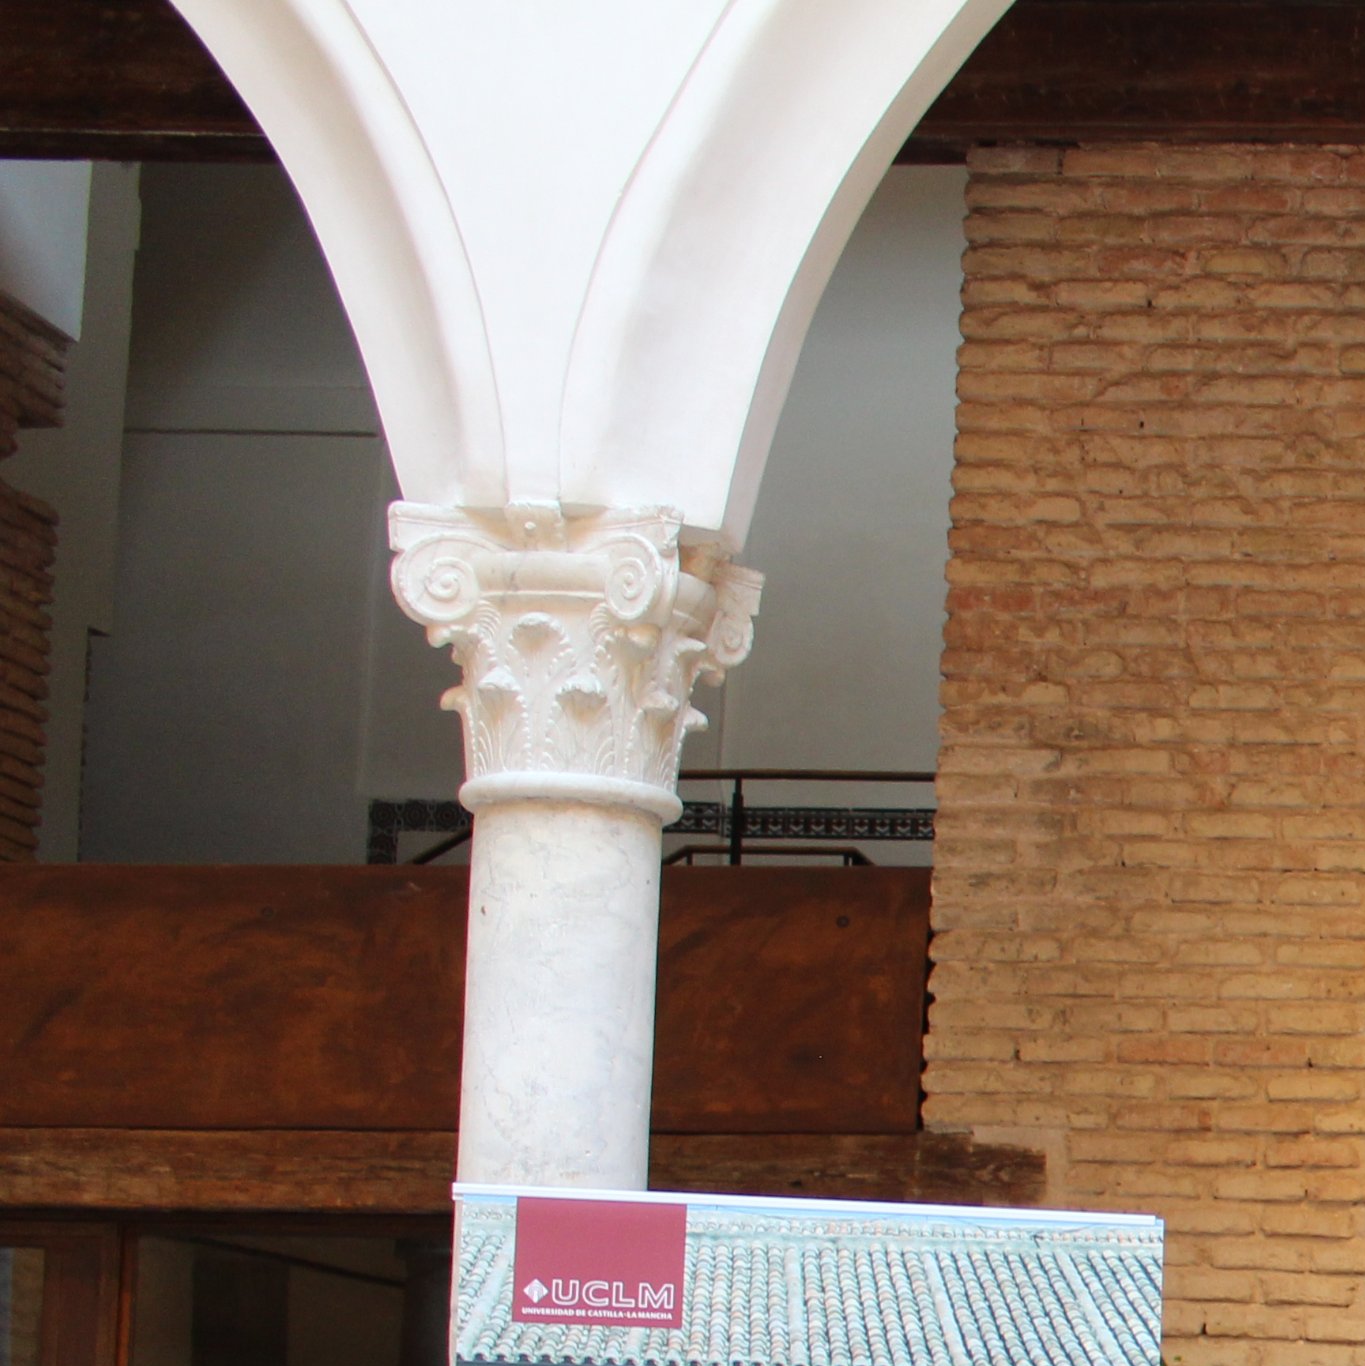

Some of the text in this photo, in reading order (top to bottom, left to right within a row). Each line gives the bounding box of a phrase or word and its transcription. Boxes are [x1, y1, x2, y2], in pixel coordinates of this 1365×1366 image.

[552, 1278, 675, 1310] UCLM
[521, 1306, 575, 1317] UNIVERSIDAD
[575, 1309, 586, 1318] DE
[637, 1311, 673, 1321] MANCHA
